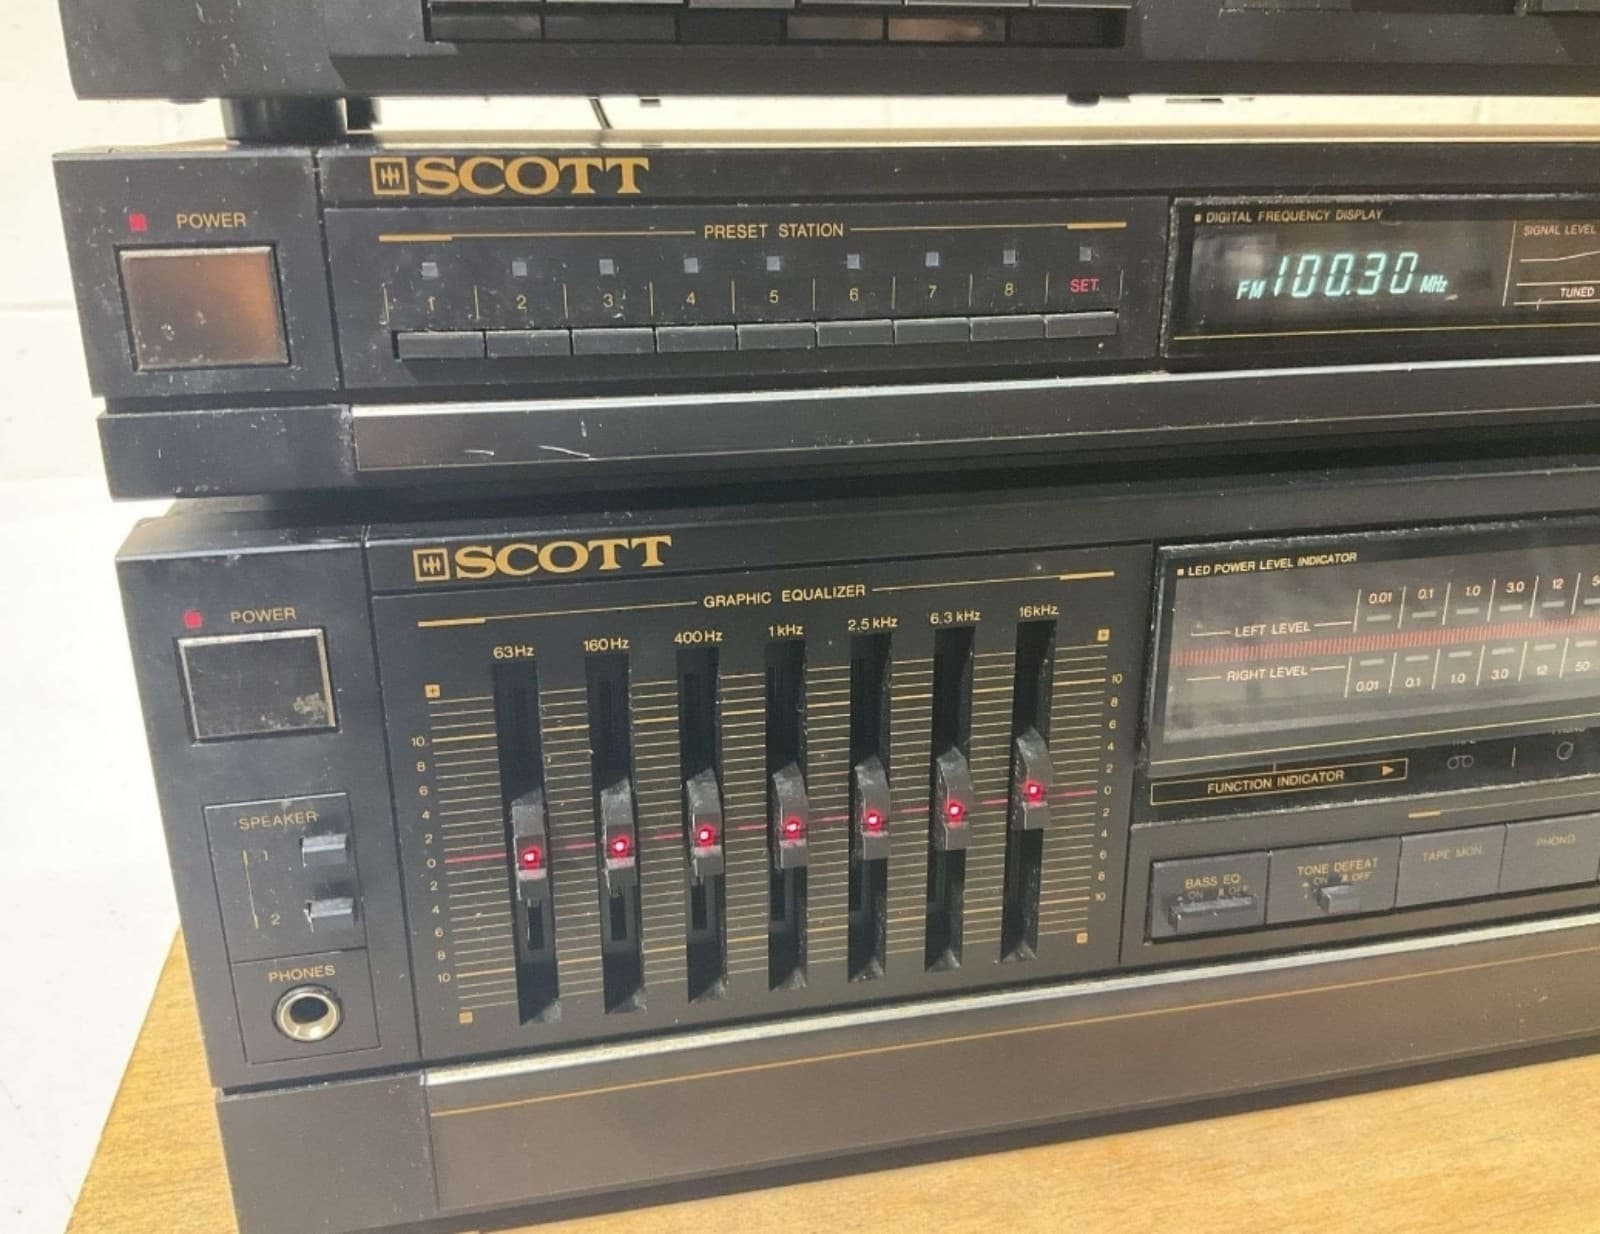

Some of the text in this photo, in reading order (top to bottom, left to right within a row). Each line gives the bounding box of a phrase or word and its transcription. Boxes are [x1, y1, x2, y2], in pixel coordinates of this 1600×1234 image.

[415, 156, 649, 195] SCOTT
[176, 212, 247, 229] POWER
[1206, 209, 1383, 224] DIGITAL FREQUENCY DISPLAY
[704, 222, 844, 240] PRESET STATION
[1523, 224, 1596, 236] SIGNAL LEVEL
[1236, 251, 1449, 300] FM 100.30 MHz
[928, 285, 938, 299] 7
[1004, 282, 1014, 297] 8
[1070, 279, 1098, 293] SET
[1560, 287, 1595, 298] TUNED
[603, 293, 614, 308] 3
[685, 291, 696, 306] 4
[769, 290, 779, 304] 5
[849, 288, 859, 302] 6
[516, 295, 527, 310] 2
[454, 535, 672, 580] SCOTT
[1188, 552, 1358, 577] LED POWER LEVEL INDICATOR
[1506, 581, 1526, 593] 3.0
[1552, 577, 1565, 590] 12
[703, 584, 866, 608] GRAPHIC EQUALIZER
[1418, 588, 1435, 600] 0.1
[1465, 584, 1482, 597] 1.0
[1368, 592, 1393, 604] 0.01
[230, 607, 296, 624] POWER
[1235, 621, 1311, 638] LEFT LEVEL
[1575, 660, 1591, 672] 50
[1111, 674, 1123, 685] 10
[1226, 665, 1308, 682] RIGHT LEVEL
[1450, 672, 1467, 684] 1.0
[1491, 668, 1509, 681] 3.0
[1355, 680, 1380, 693] 0.01
[1405, 676, 1422, 689] 0.1
[1110, 697, 1119, 708] 8
[1108, 719, 1117, 729] 6
[411, 736, 425, 748] 10
[1107, 741, 1114, 751] 4
[416, 761, 426, 772] 8
[1105, 764, 1113, 773] 2
[1207, 769, 1345, 794] FUNCTION INDICATOR
[418, 785, 428, 796] 6
[1104, 785, 1112, 795] 0
[421, 810, 430, 820] 4
[1102, 807, 1110, 817] 2
[238, 811, 319, 830] SPEAKER
[424, 834, 433, 844] 2
[1101, 828, 1108, 838] 4
[1423, 845, 1482, 862] TAPE MON
[427, 858, 436, 869] 0
[1297, 857, 1378, 877] TONE DEFEAT
[1185, 875, 1218, 889] BASS
[1351, 872, 1372, 883] OFF
[430, 880, 438, 891] 2
[432, 905, 440, 914] 4
[270, 913, 281, 926] 2
[434, 927, 444, 938] 6
[437, 951, 446, 960] 8
[268, 964, 336, 983] PHONES
[438, 973, 451, 983] 10
